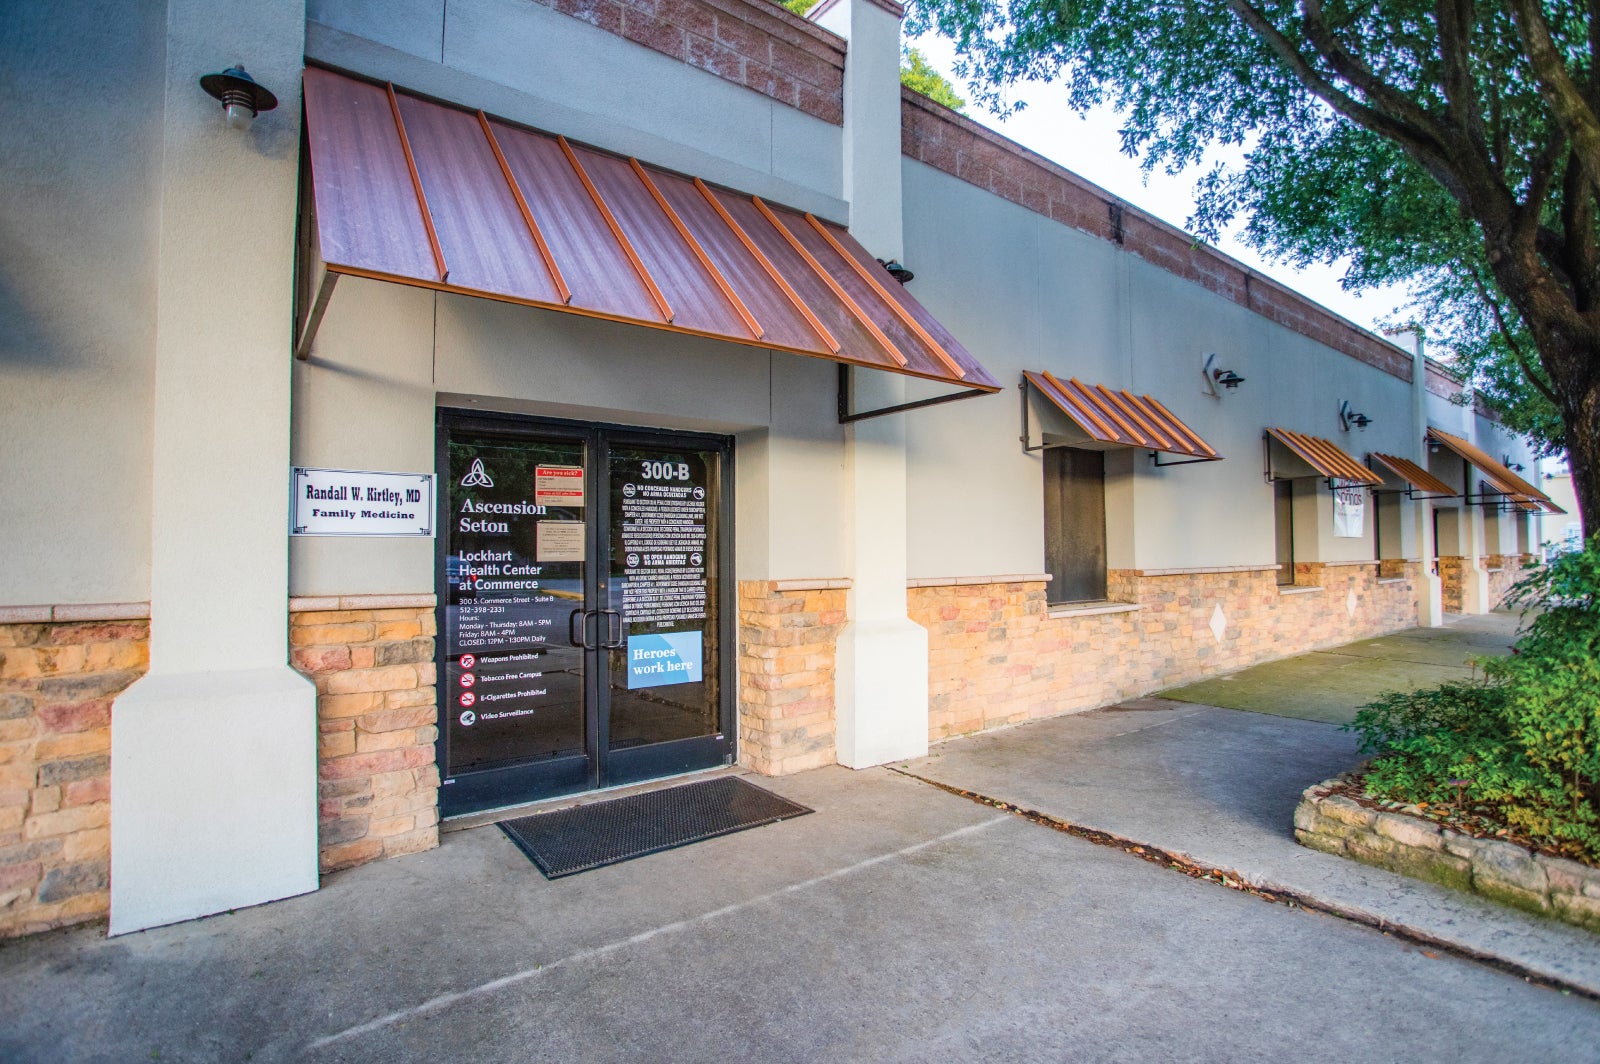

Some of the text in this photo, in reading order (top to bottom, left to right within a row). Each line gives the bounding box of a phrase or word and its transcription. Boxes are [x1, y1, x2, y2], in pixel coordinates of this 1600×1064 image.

[641, 461, 690, 481] 300-B
[306, 484, 421, 506] Randall W. Kirtley, MD
[460, 498, 547, 515] Ascension
[312, 509, 415, 520] Family Medicine
[460, 518, 509, 533] Seton
[460, 550, 512, 562] Lockhart
[460, 565, 542, 576] Health Center
[460, 580, 538, 591] at Commerce
[480, 653, 539, 664] Weapons Prohibited
[633, 648, 676, 660] Heroes
[633, 660, 694, 676] work here
[518, 671, 542, 679] Campus
[480, 688, 547, 702] E-Cigarettes Prohibited
[498, 708, 534, 718] Surveillance
